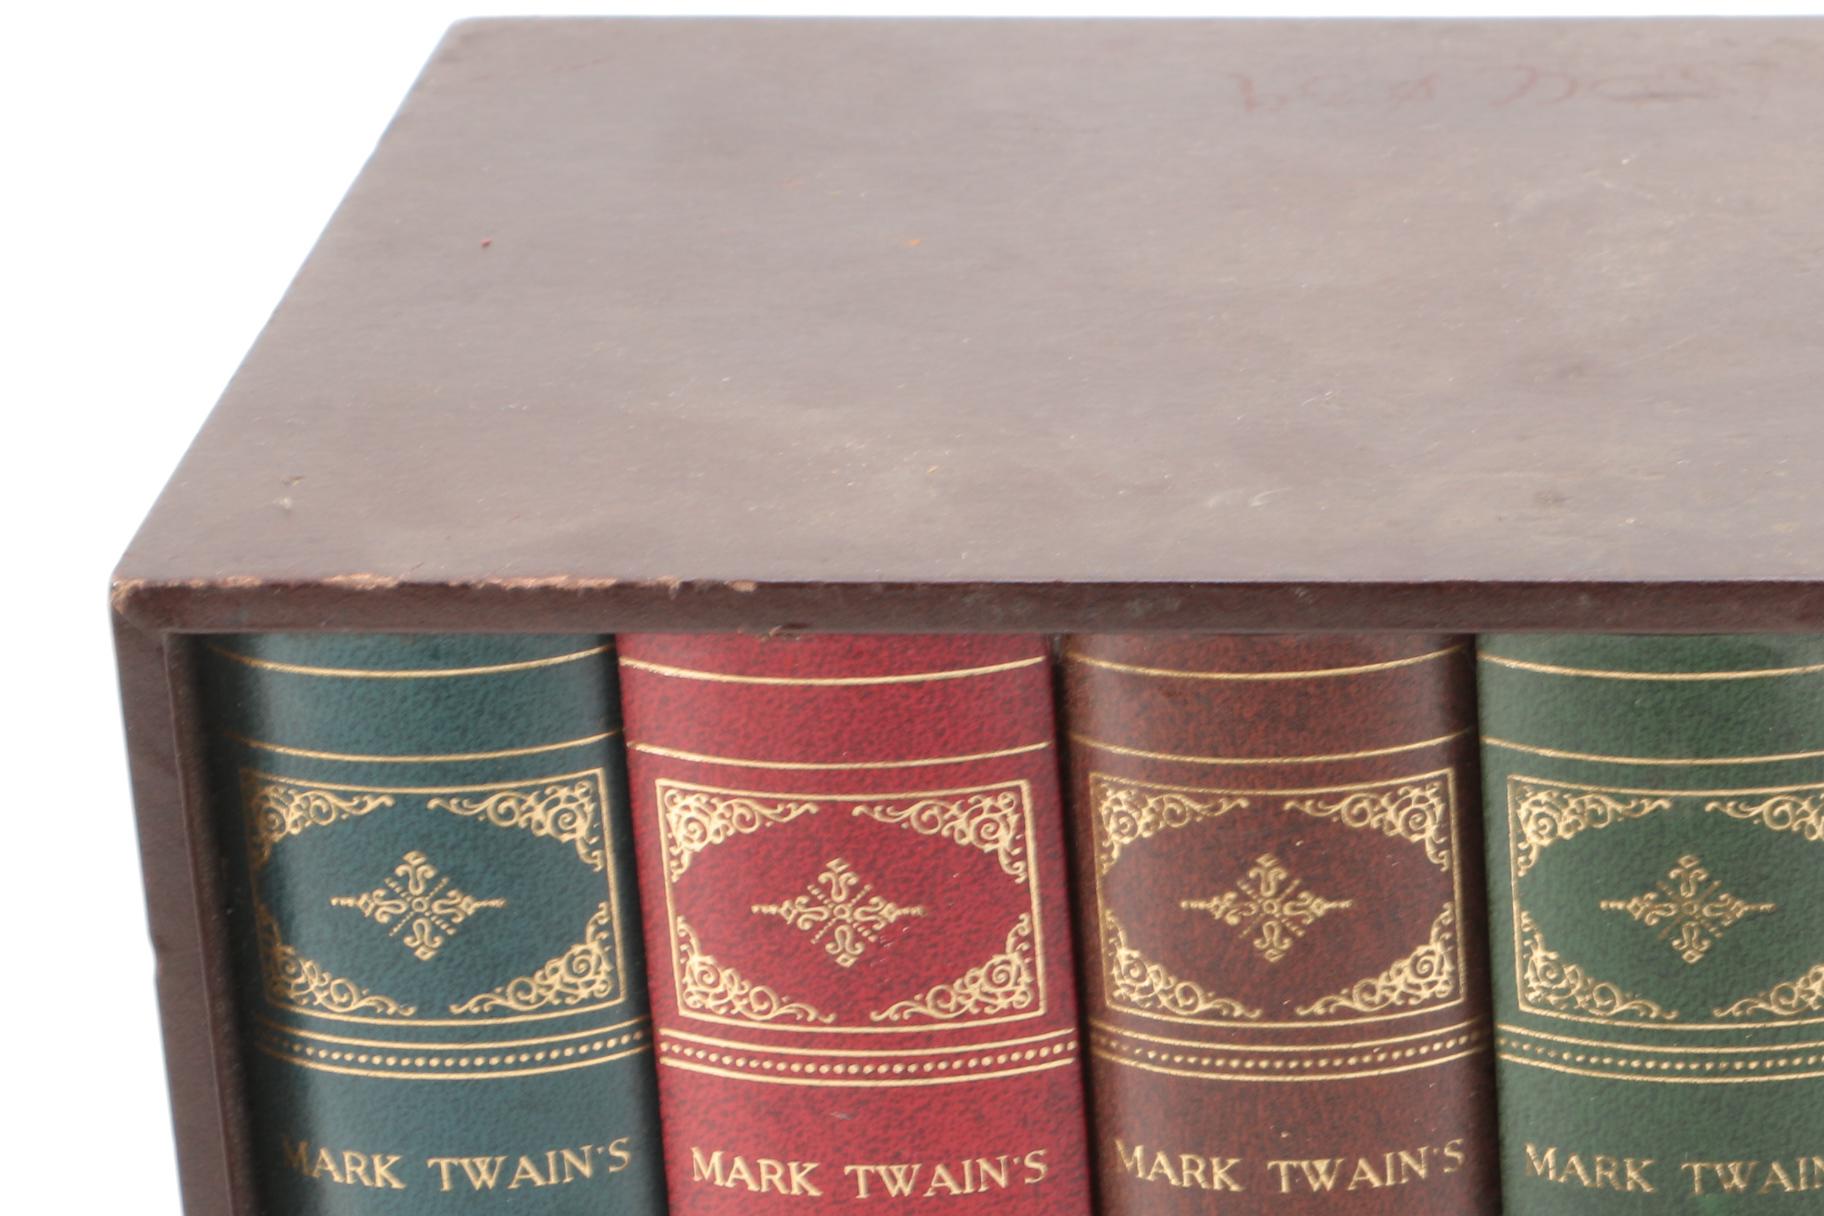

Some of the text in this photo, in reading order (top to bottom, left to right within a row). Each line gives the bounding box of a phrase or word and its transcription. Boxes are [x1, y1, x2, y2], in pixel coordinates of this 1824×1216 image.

[283, 1136, 633, 1191] MARK TWAIN'S
[691, 1146, 1048, 1199] MARK TWAIN'S
[1114, 1139, 1466, 1193] MARK TWAIN'S
[1523, 1143, 1654, 1194] MARK
